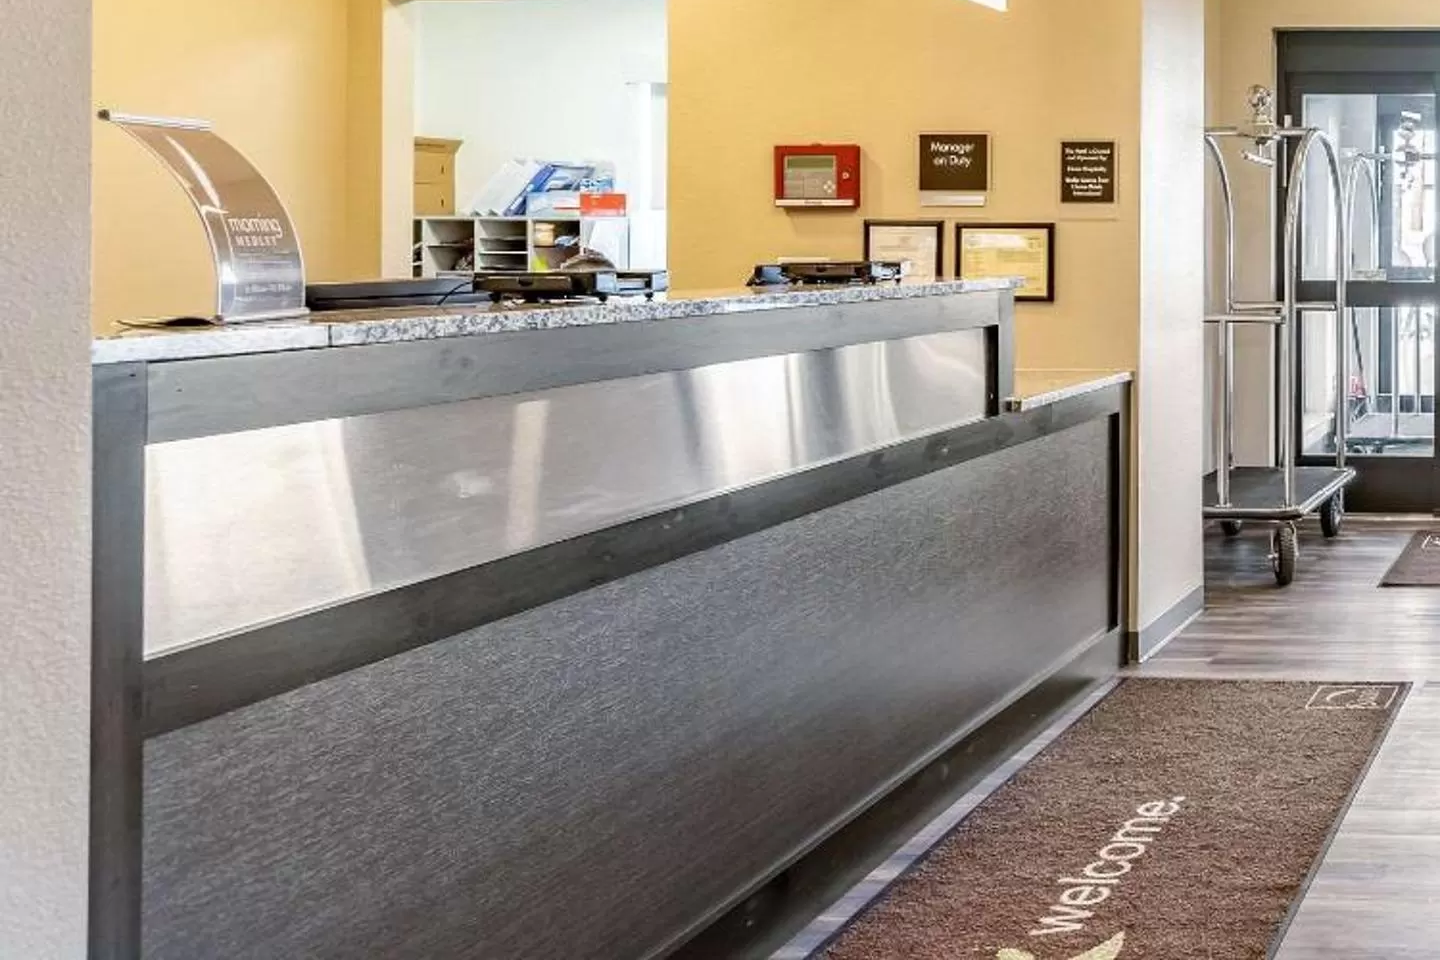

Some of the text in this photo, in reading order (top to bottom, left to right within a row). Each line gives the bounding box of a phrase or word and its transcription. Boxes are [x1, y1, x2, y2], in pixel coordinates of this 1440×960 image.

[930, 141, 975, 155] Manager
[933, 154, 973, 168] on Duty
[227, 211, 283, 239] morning
[1028, 795, 1187, 936] welcome.
